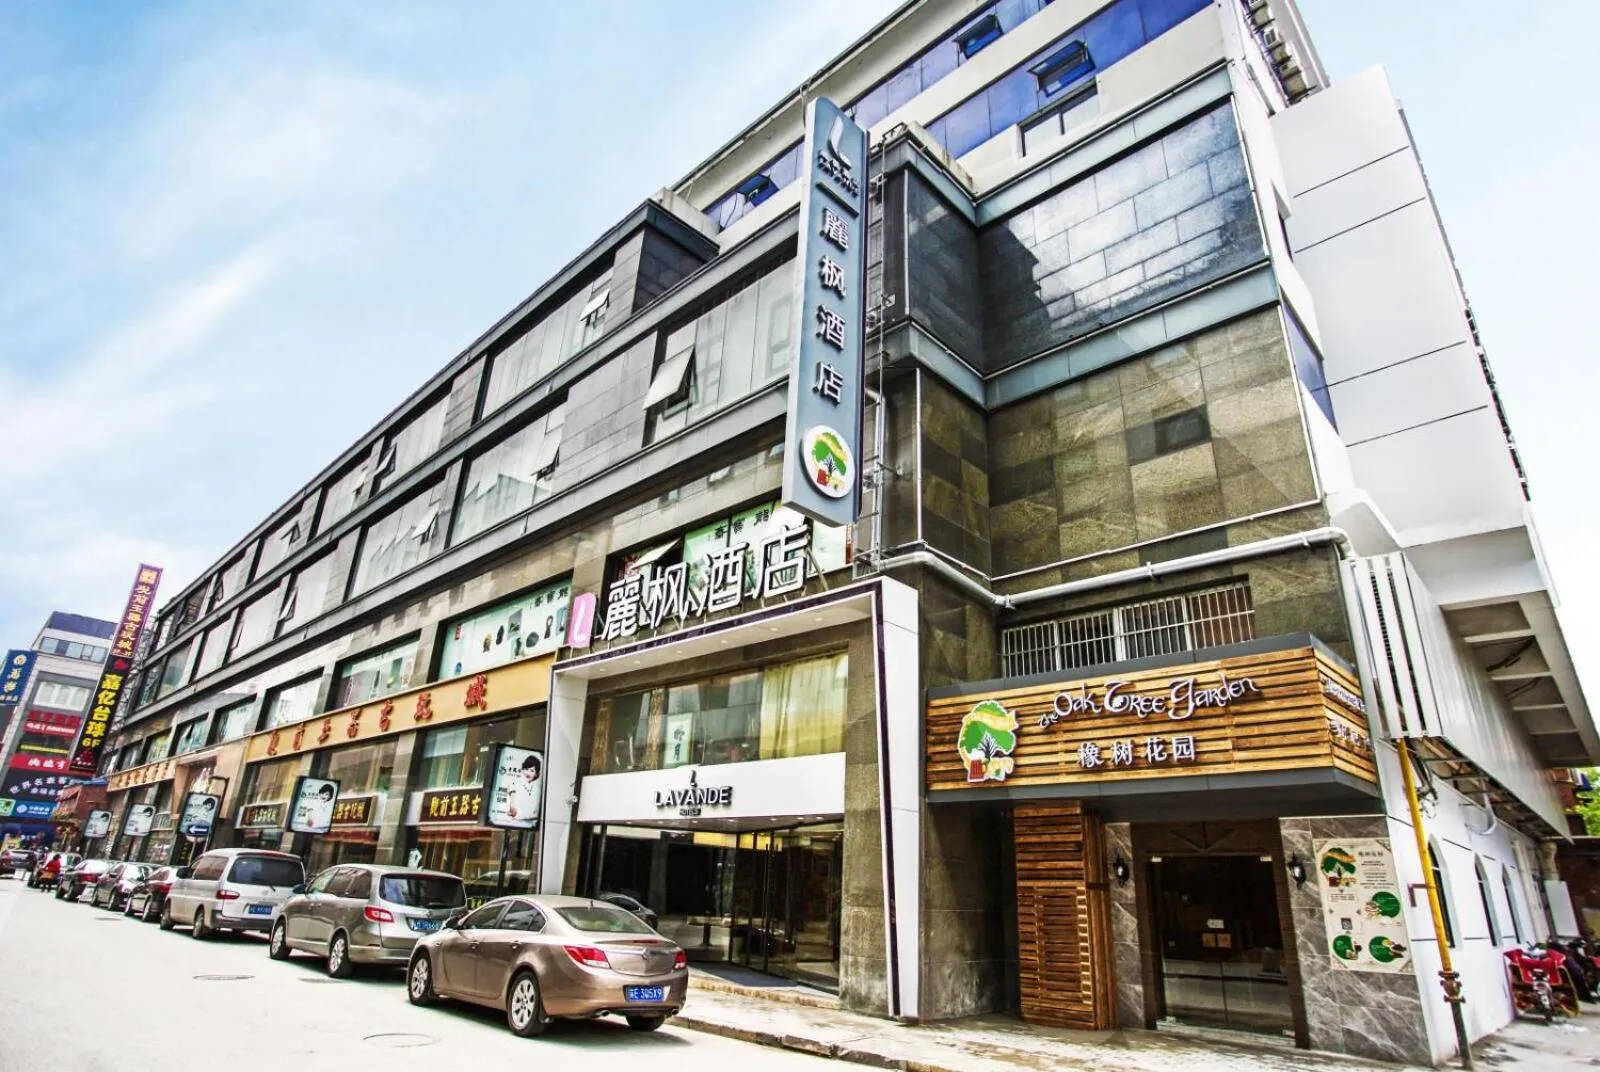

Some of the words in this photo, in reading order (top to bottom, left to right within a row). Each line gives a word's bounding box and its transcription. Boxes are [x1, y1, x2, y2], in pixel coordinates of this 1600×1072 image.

[1053, 682, 1101, 716] Oak
[1077, 735, 1197, 769] 橡树花园
[654, 786, 734, 808] LAVANDE
